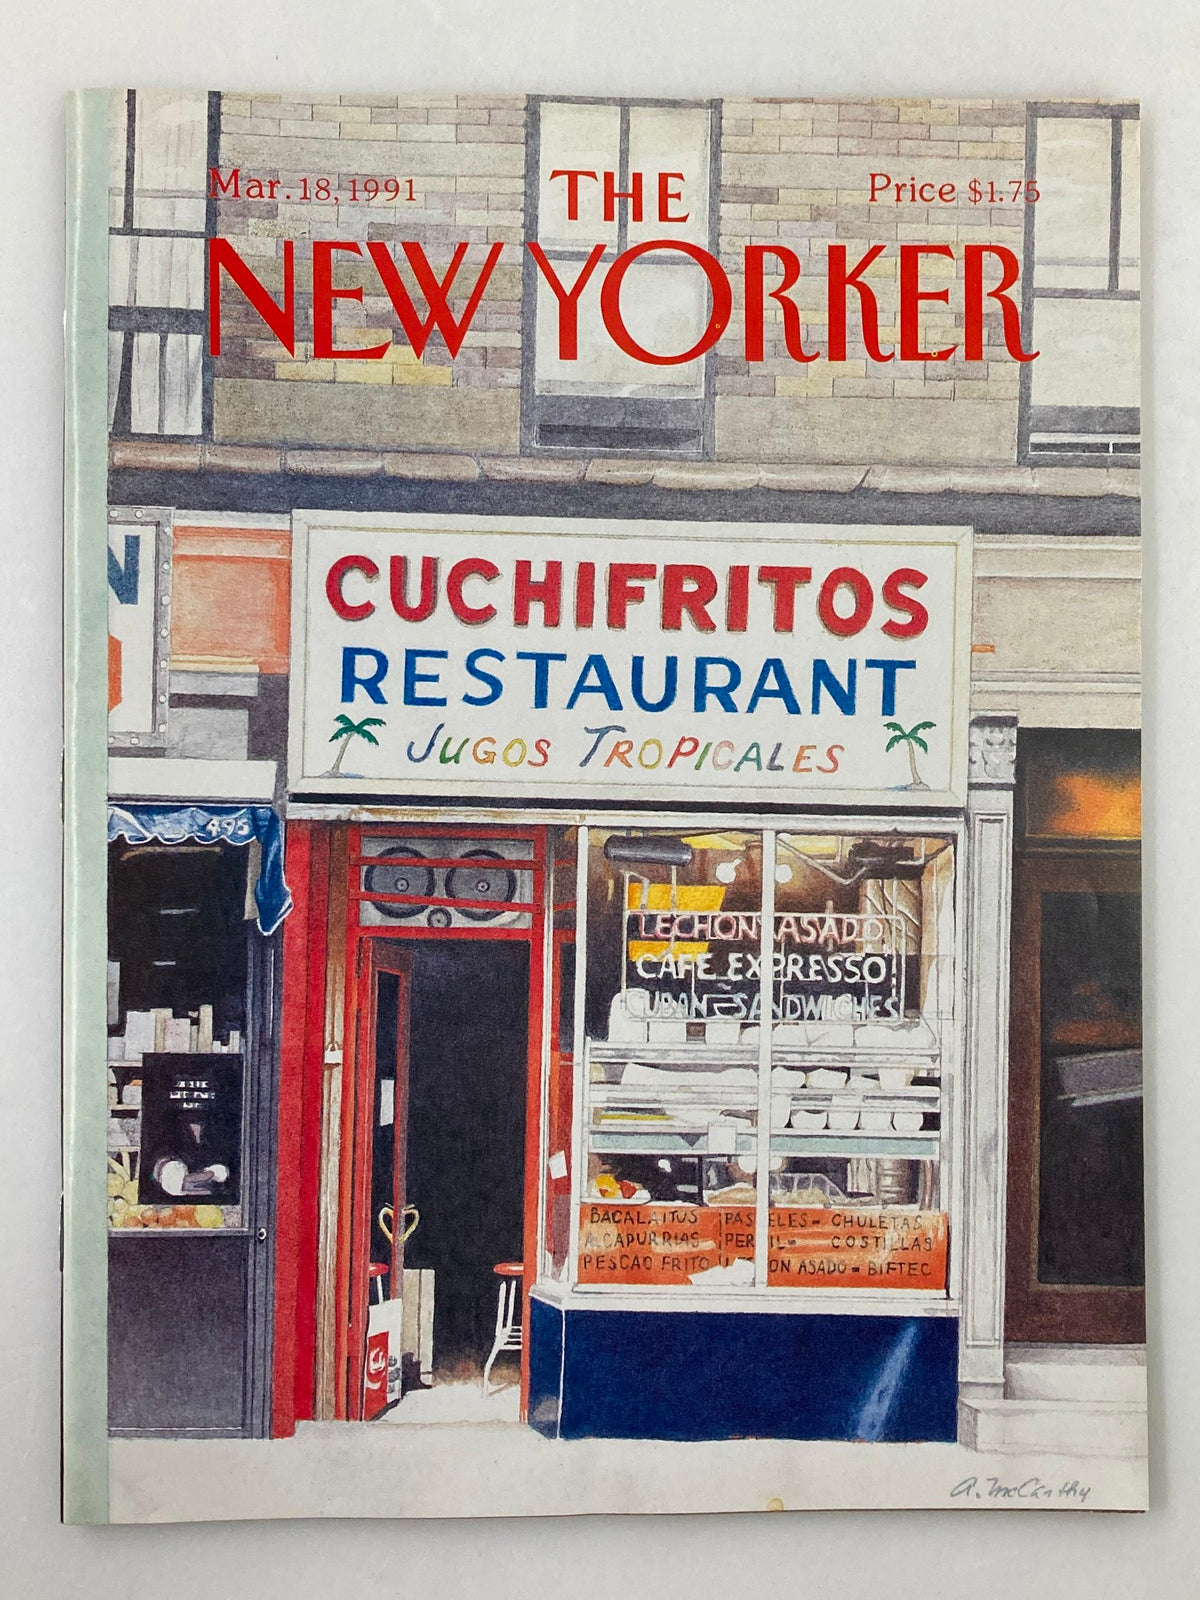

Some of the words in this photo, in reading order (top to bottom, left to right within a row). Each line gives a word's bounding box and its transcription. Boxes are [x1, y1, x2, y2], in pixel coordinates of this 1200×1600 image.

[208, 168, 291, 200] Mar.
[348, 178, 417, 202] 1991
[549, 169, 690, 223] THE
[868, 173, 956, 203] Price
[968, 178, 1041, 205] $1.75
[208, 238, 505, 361] NEW
[526, 239, 1041, 366] YORKER
[325, 554, 930, 641] CUCHIFRITOS
[340, 645, 917, 717] RESTAURANT
[406, 723, 551, 767] JUGOS
[579, 724, 845, 773] TROPICALES
[638, 914, 759, 941] LECHON
[776, 917, 884, 945] ASADO
[635, 952, 717, 980] CAFE
[727, 952, 887, 984] EXPRESSO
[725, 1212, 808, 1228] PASELES
[831, 1213, 923, 1231] CHULETAS
[725, 1233, 786, 1250] PERIL
[661, 1255, 710, 1272] FRITO
[868, 1261, 932, 1277] BIFTEC
